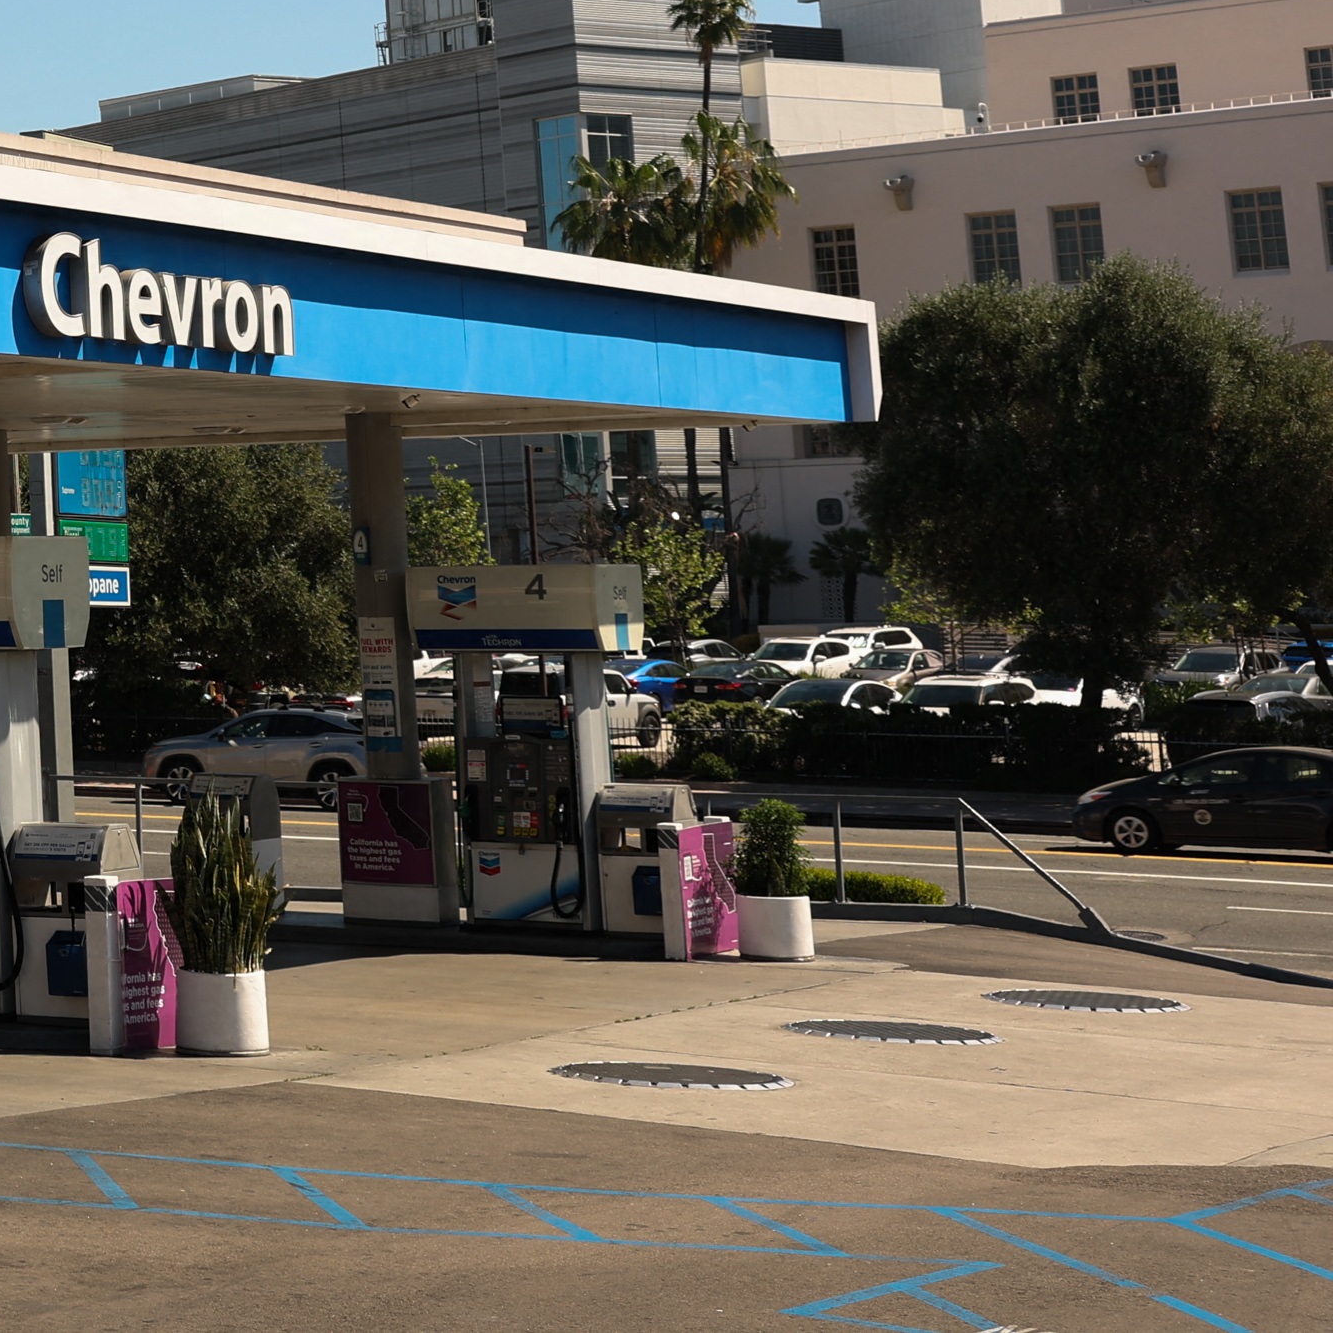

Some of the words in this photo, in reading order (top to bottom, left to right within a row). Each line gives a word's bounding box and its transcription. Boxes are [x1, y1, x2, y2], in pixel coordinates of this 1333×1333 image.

[30, 231, 295, 357] Chevron
[41, 564, 63, 584] Self
[436, 574, 476, 584] Chevron
[524, 573, 547, 601] 4
[613, 585, 627, 601] Self
[374, 638, 394, 646] WITH
[481, 637, 522, 647] TECHRON
[362, 645, 392, 653] REWARDS
[349, 838, 384, 847] California
[384, 839, 399, 847] has
[359, 846, 386, 856] highest
[387, 848, 402, 856] gas
[349, 854, 367, 862] taxes
[362, 862, 395, 871] America.
[147, 971, 162, 981] has
[151, 985, 165, 996] gas
[131, 999, 145, 1010] and
[146, 998, 164, 1008] fees
[124, 1012, 158, 1024] America.
